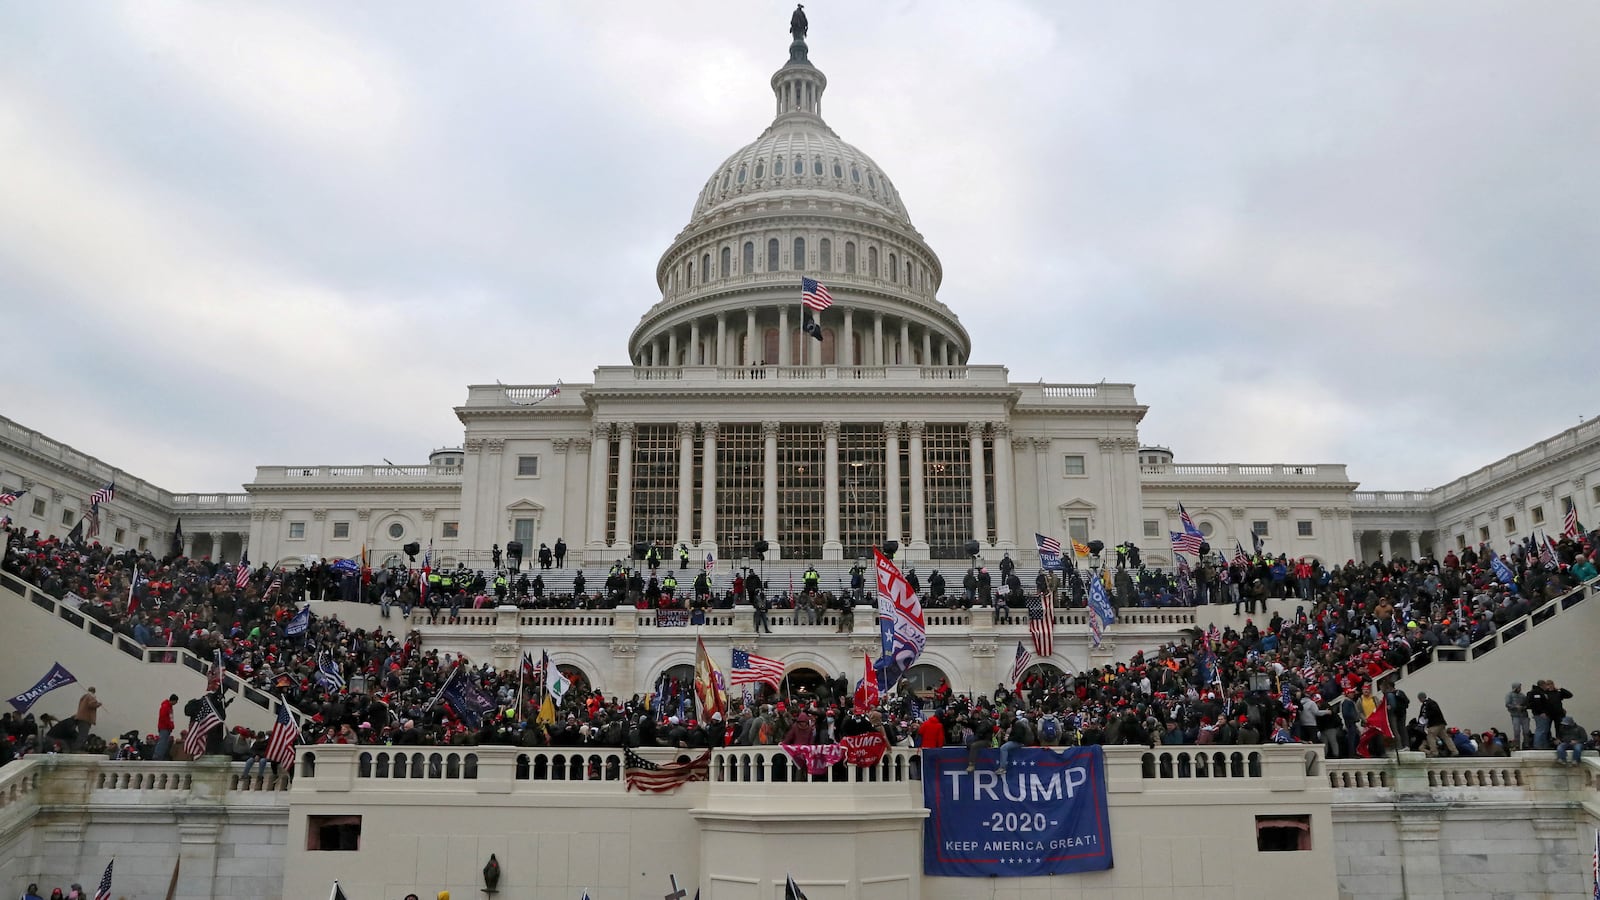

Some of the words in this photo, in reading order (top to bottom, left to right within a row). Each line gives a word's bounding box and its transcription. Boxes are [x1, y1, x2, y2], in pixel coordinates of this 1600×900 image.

[846, 736, 882, 749] RUMP
[944, 767, 1087, 802] TRUMP
[946, 841, 979, 851] KEEP
[983, 841, 1044, 851] AMERICA
[1049, 835, 1097, 849] GREAT!
